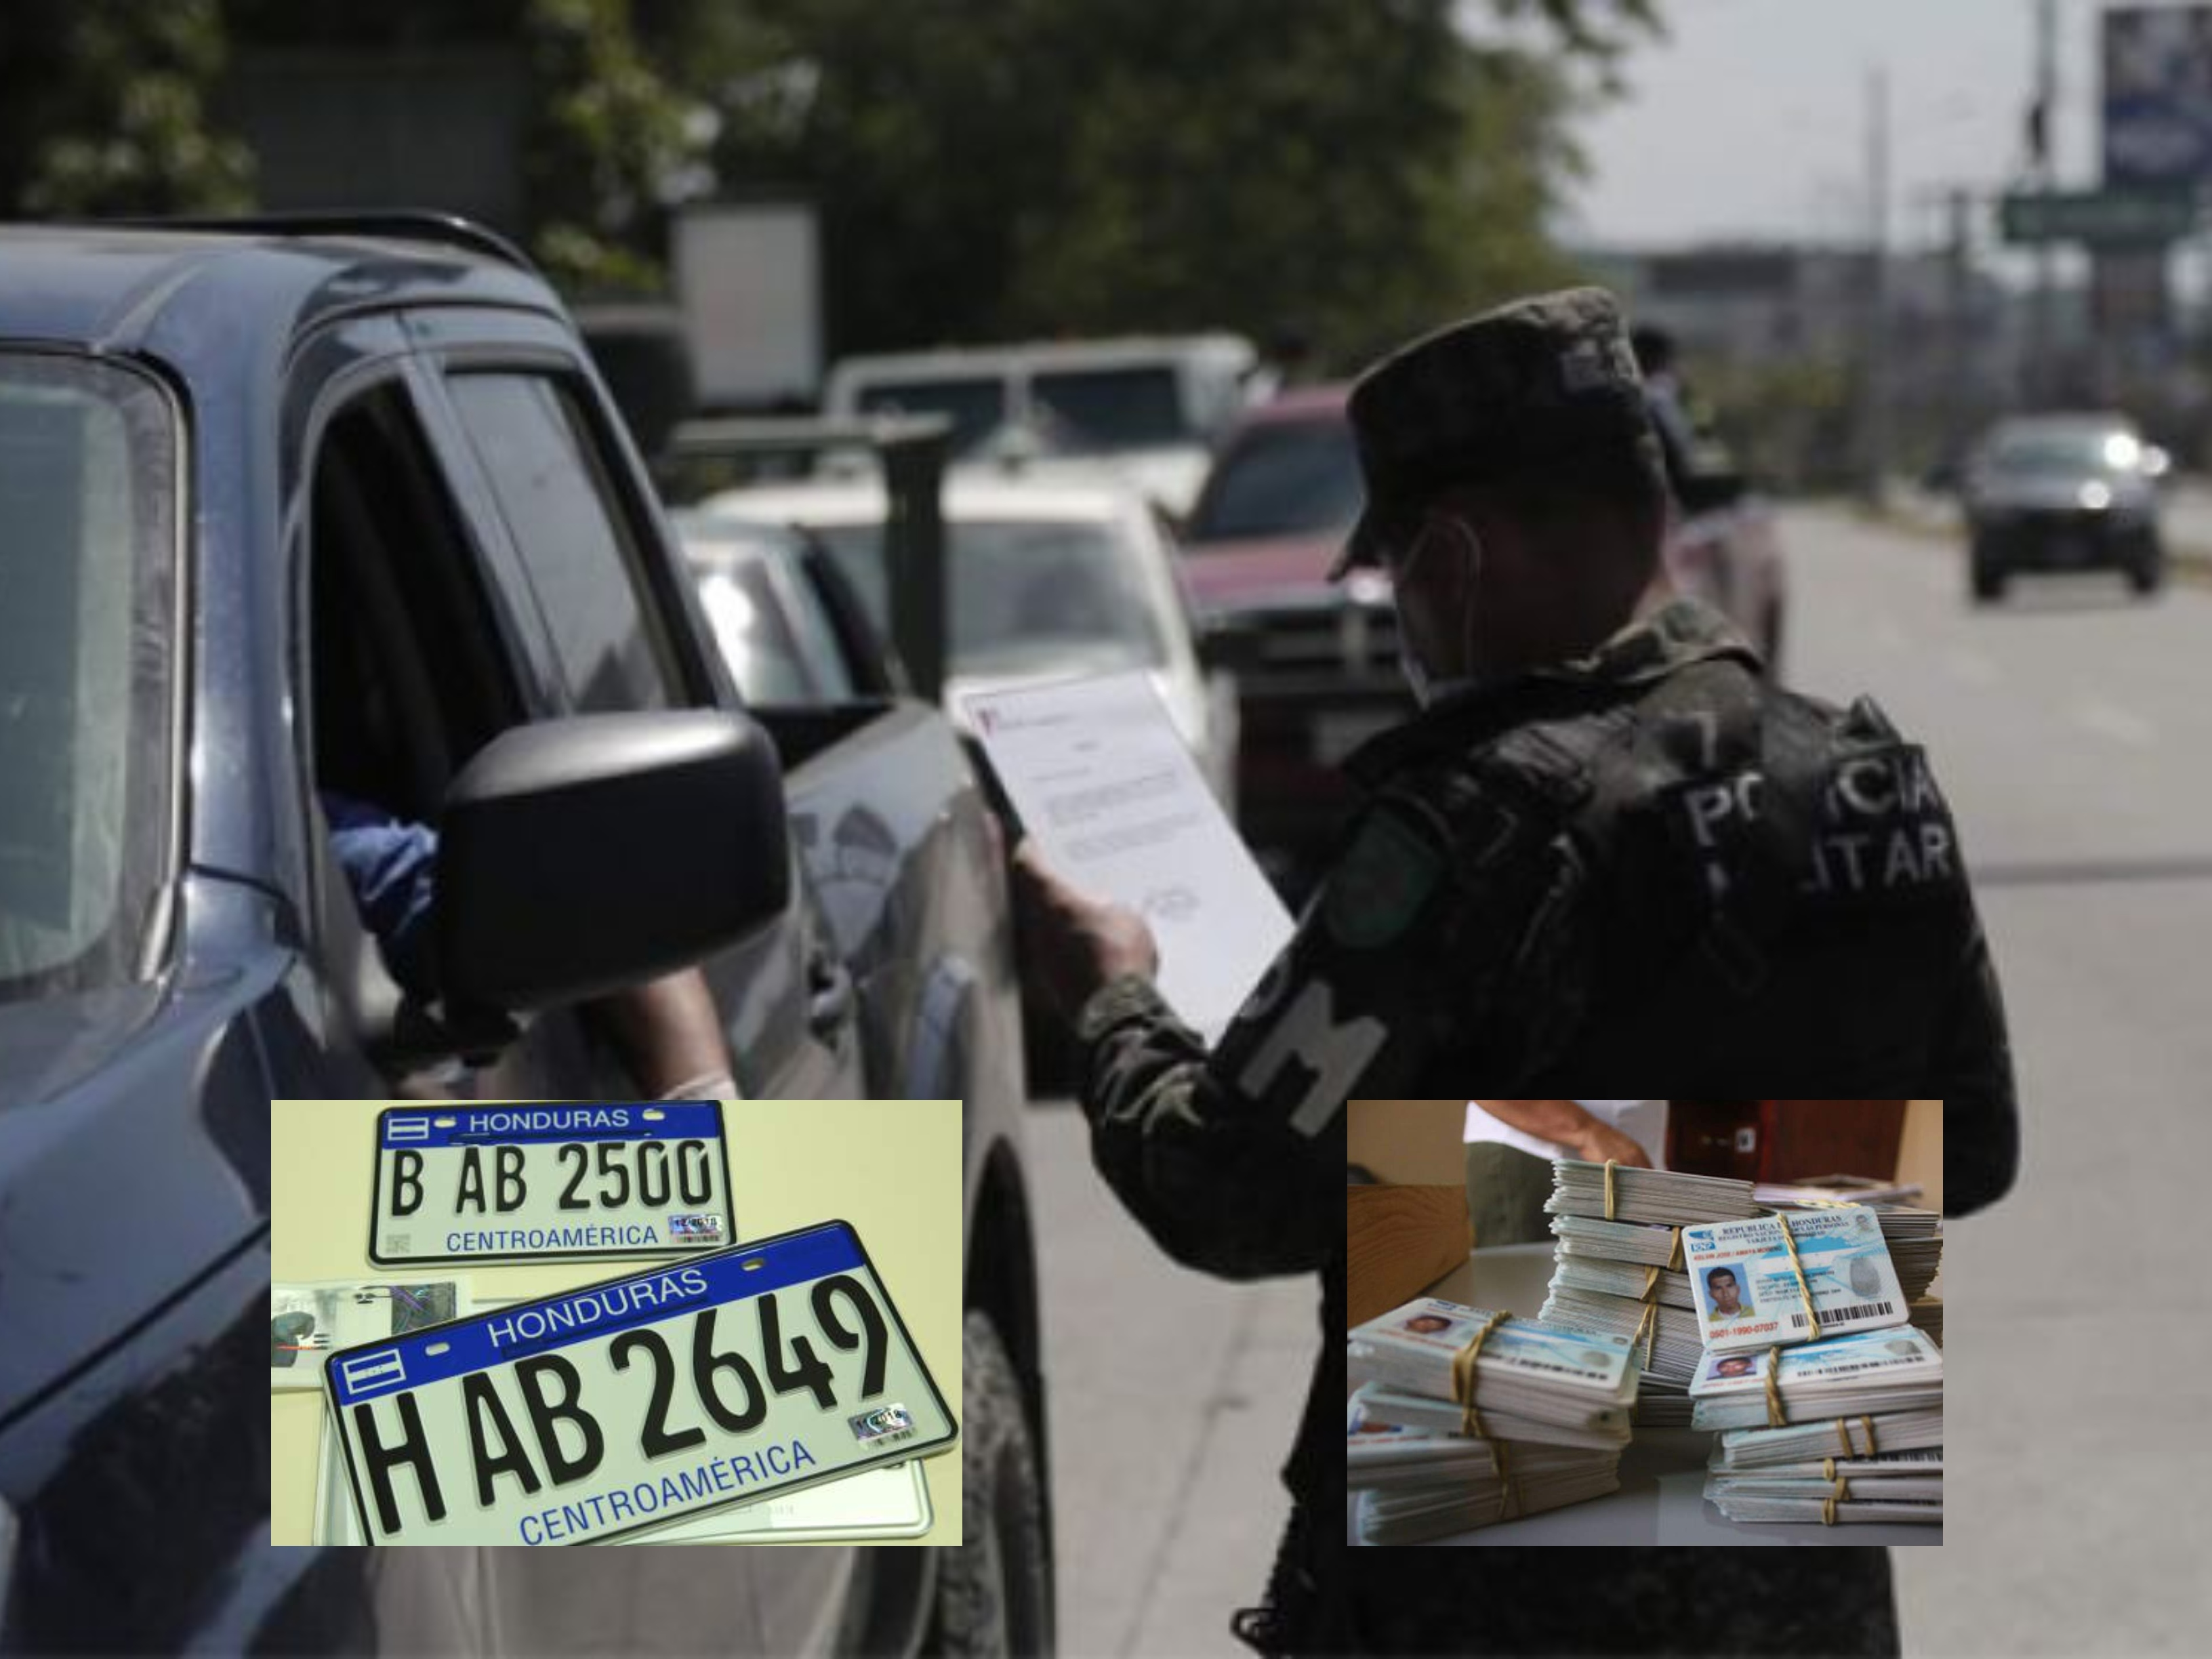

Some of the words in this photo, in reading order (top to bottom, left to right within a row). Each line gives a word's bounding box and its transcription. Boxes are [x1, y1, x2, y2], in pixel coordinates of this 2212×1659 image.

[470, 1109, 630, 1133] HONDURAS
[391, 1149, 424, 1216] B
[455, 1144, 527, 1214] AB
[557, 1139, 712, 1210] 2500
[445, 1222, 658, 1252] CENTROAMÉRICA
[487, 1269, 708, 1348] HONDURAS
[353, 1391, 445, 1534] H
[462, 1351, 605, 1507] AB
[609, 1274, 890, 1460] 2649
[520, 1439, 815, 1545] CENTROAMÉRICA
